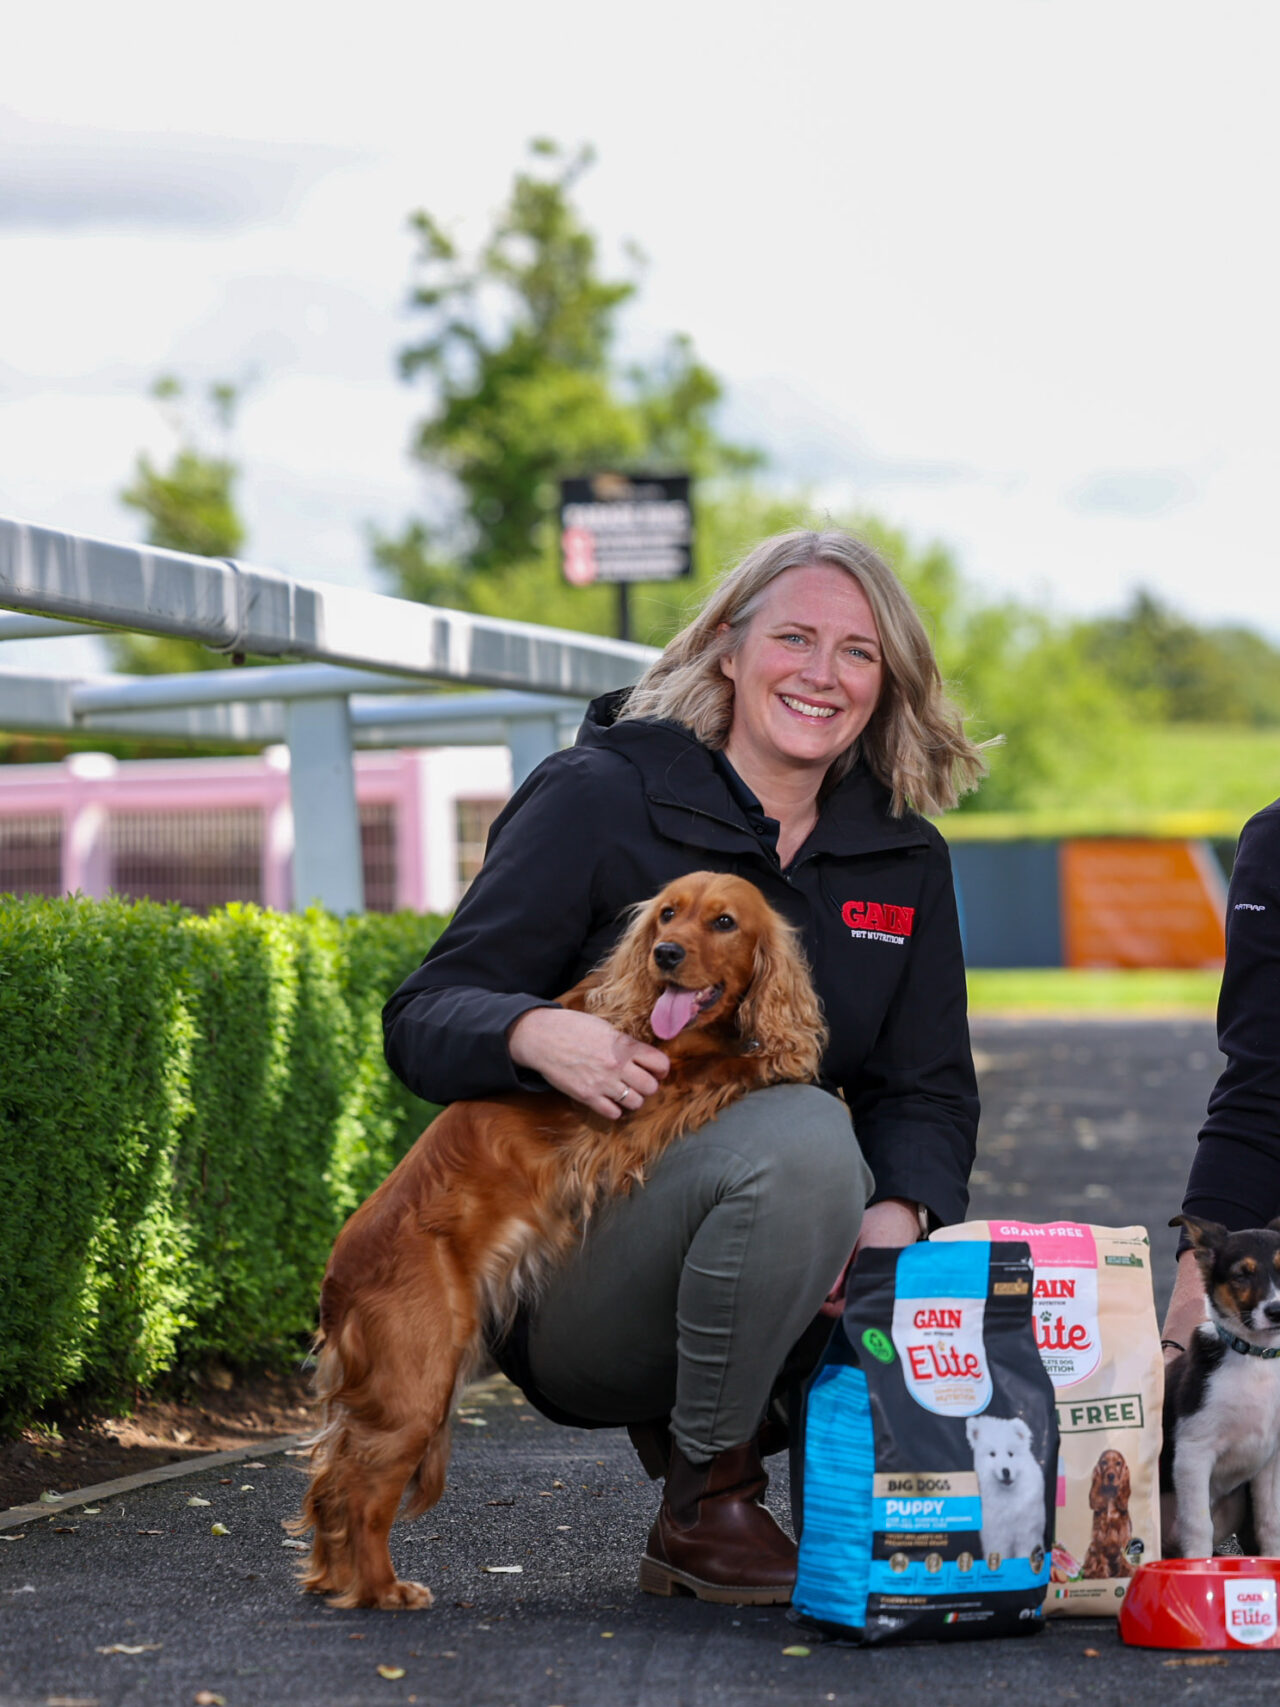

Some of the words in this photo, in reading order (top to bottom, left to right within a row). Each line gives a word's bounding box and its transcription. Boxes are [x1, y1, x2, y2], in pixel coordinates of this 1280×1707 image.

[842, 900, 914, 936] GAIN
[851, 930, 867, 938] PET
[867, 932, 904, 944] NUTRITION
[1000, 1226, 1046, 1237] GRAIN
[1050, 1227, 1084, 1238] FREE
[1033, 1280, 1076, 1299] AIN
[913, 1309, 963, 1330] GAIN
[1032, 1315, 1093, 1351] lite
[906, 1344, 983, 1381] Elite
[1070, 1402, 1136, 1426] FREE
[888, 1480, 913, 1492] BIG
[917, 1479, 951, 1492] DOGS
[886, 1500, 945, 1516] PUPPY
[1231, 1609, 1273, 1626] Elite
